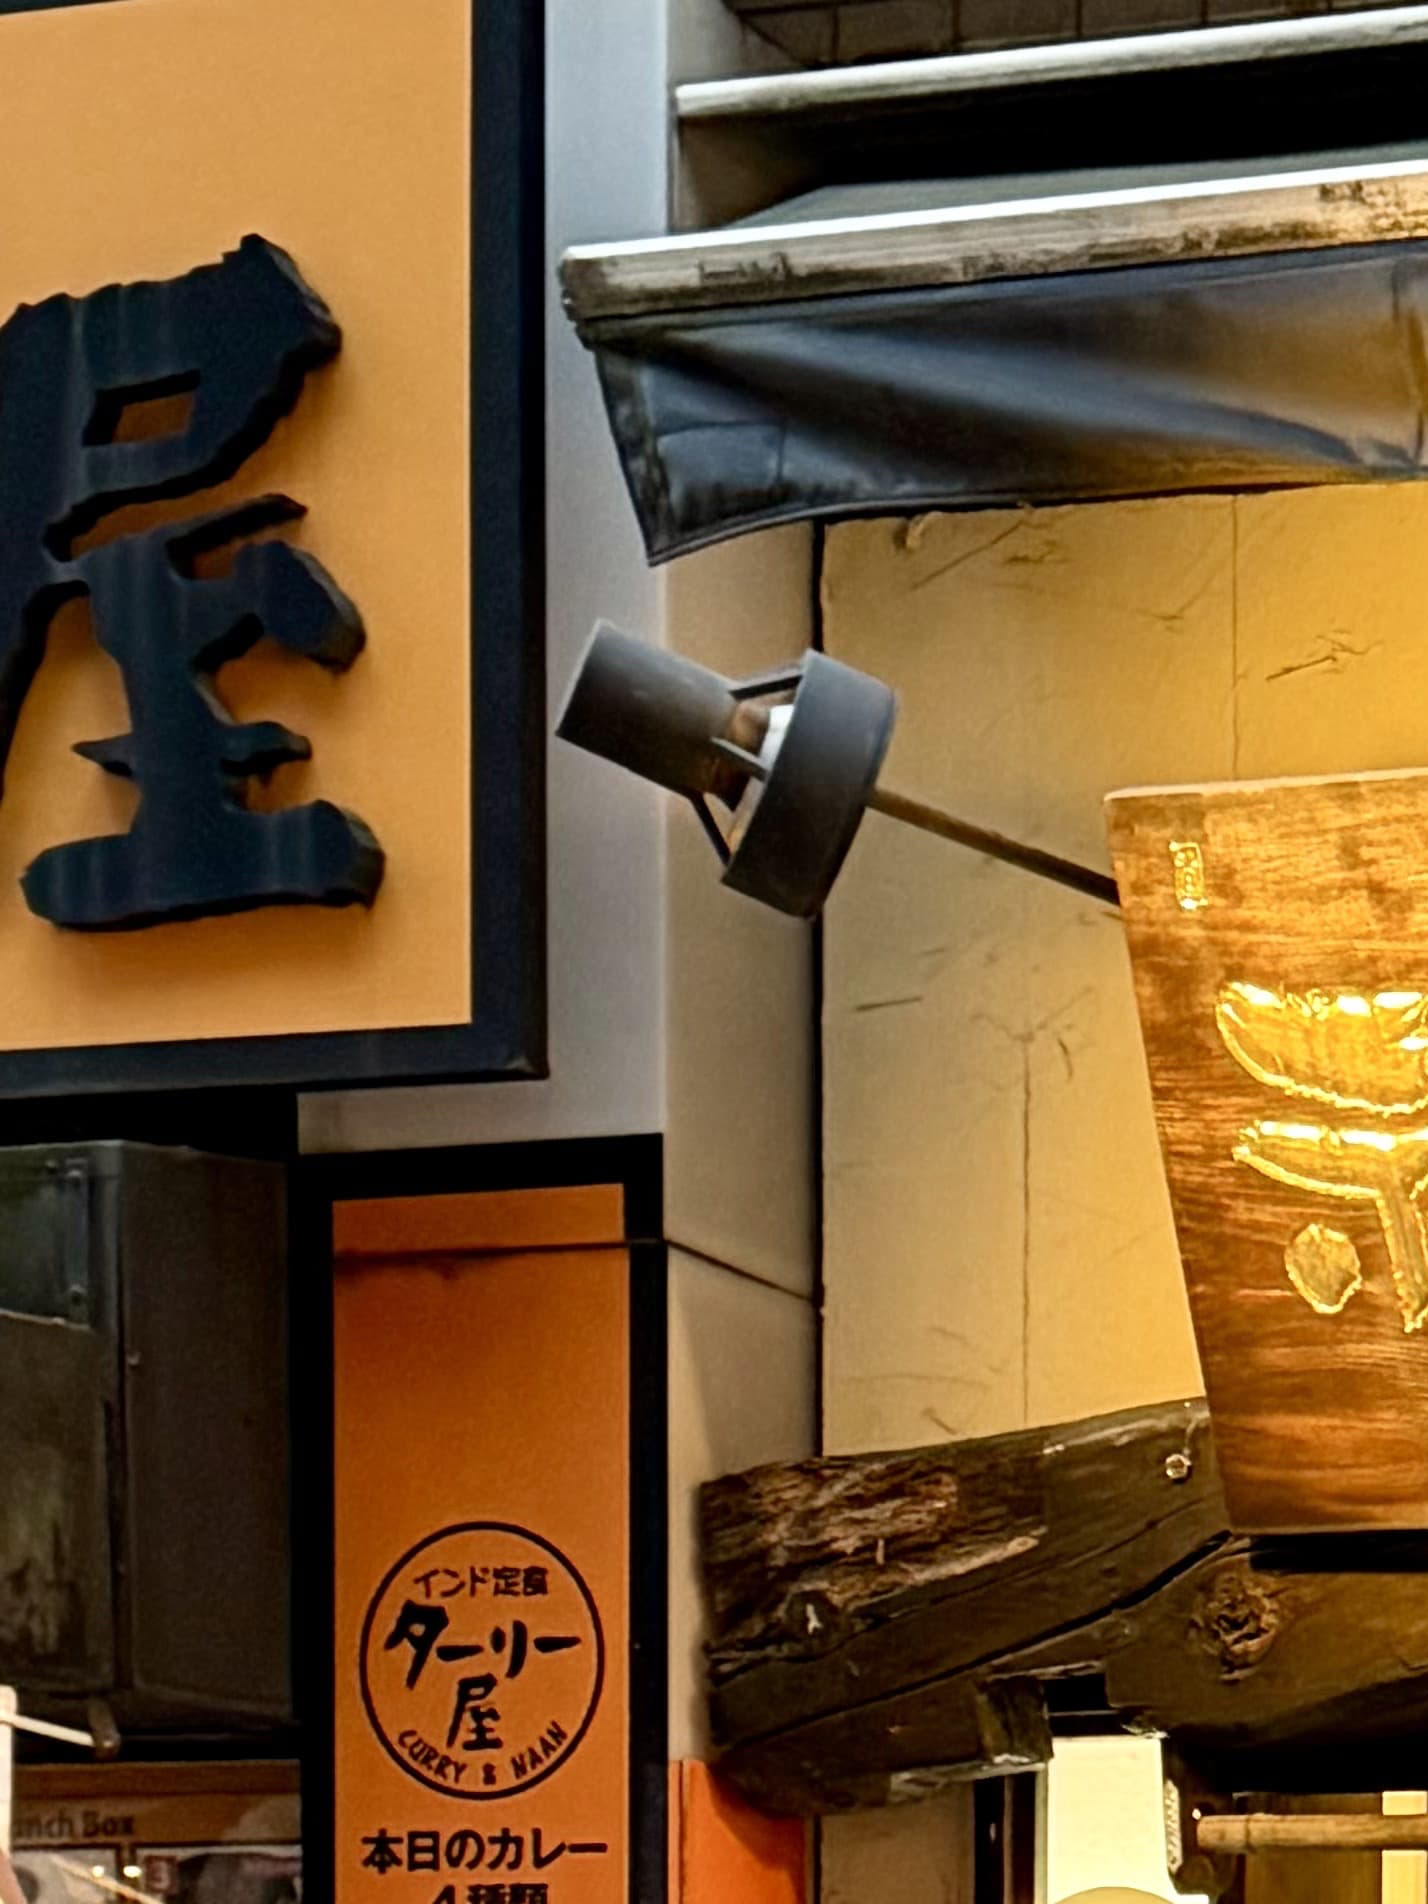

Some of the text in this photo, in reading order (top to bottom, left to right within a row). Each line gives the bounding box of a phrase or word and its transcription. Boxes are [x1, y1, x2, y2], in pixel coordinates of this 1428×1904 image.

[414, 1565, 549, 1600] インド定食
[383, 1600, 582, 1691] ターリー
[445, 1671, 504, 1751] 屋
[397, 1728, 466, 1785] CURRY
[510, 1720, 569, 1780] NAAN
[361, 1827, 608, 1875] 本日のカレー
